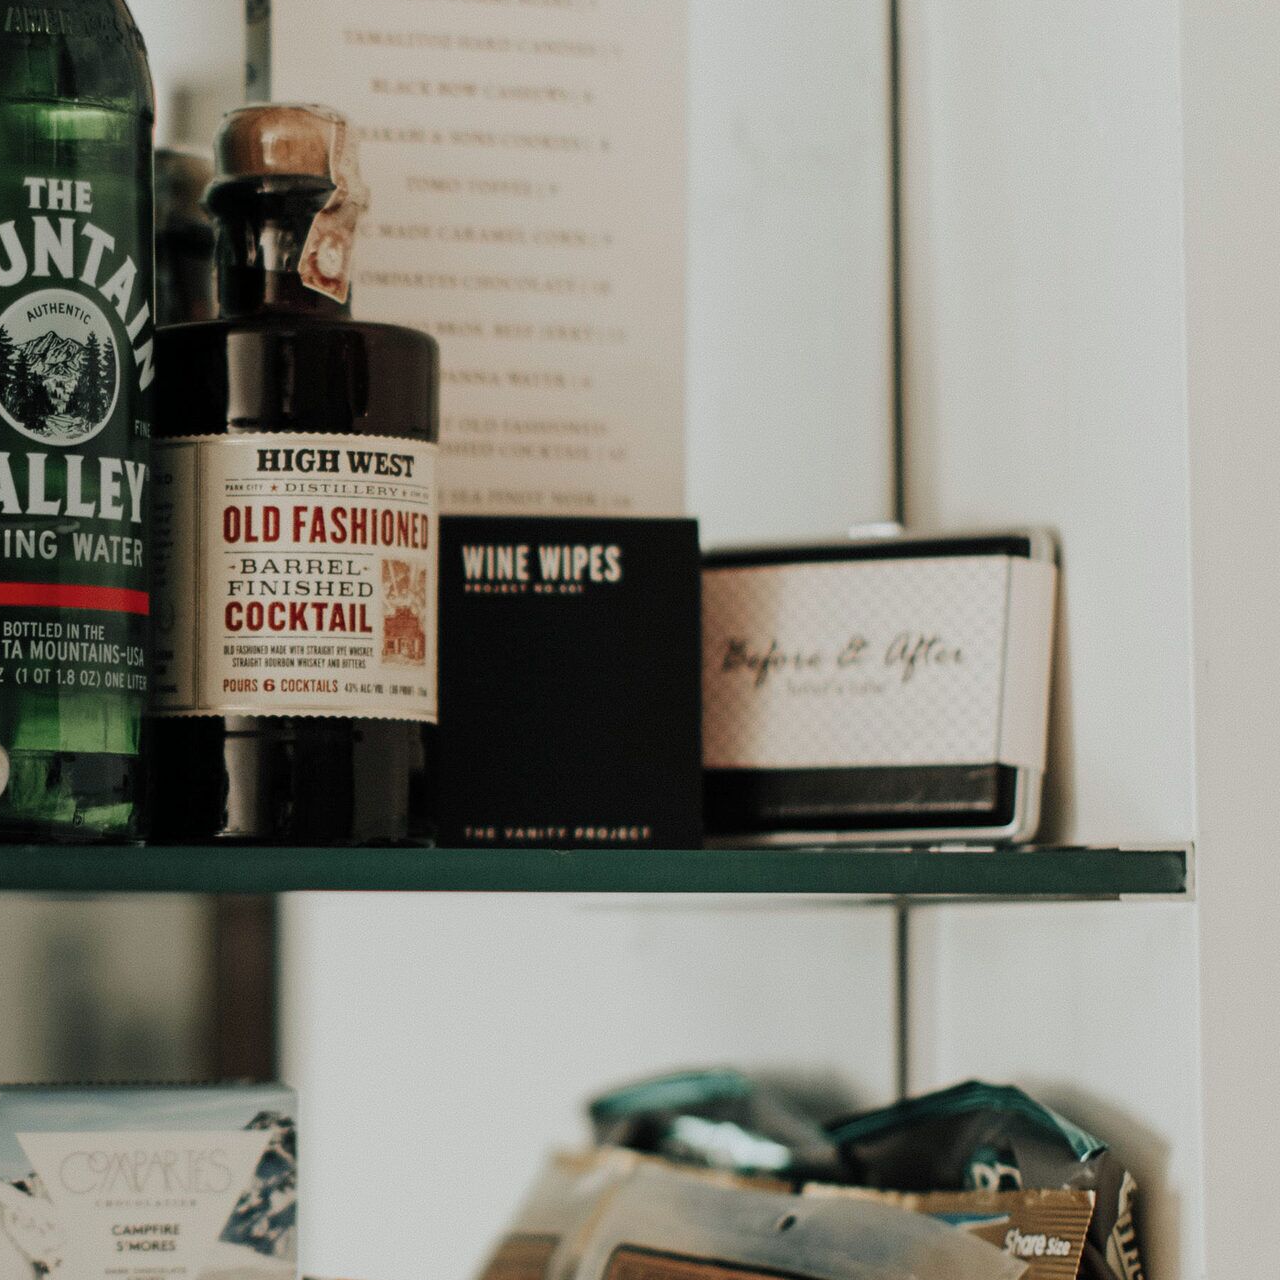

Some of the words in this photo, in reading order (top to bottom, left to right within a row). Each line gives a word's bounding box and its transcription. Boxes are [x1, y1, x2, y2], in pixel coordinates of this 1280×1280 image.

[23, 176, 93, 213] THE
[26, 302, 92, 325] AUTHENTIC
[257, 449, 340, 473] HIGH
[347, 451, 415, 477] WEST
[285, 482, 398, 498] DISTILLERY
[223, 505, 280, 545] OLD
[292, 505, 428, 550] FASHIONED
[72, 533, 143, 568] WATER
[240, 558, 362, 576] BARREL
[462, 544, 529, 581] WINE
[538, 544, 622, 582] WIPES
[227, 580, 374, 598] FINISHED
[465, 583, 527, 593] PROJECT
[224, 600, 373, 633] COCKTAIL
[3, 621, 63, 639] BOTTLED
[67, 623, 80, 639] IN
[83, 624, 105, 641] THE
[236, 645, 269, 656] FASHIONED
[721, 635, 821, 689] Before
[884, 630, 964, 684] After
[15, 667, 28, 685] (1
[34, 668, 52, 685] QT
[57, 669, 75, 686] 1.8
[80, 670, 101, 688] OZ)
[105, 671, 125, 689] ONE
[223, 679, 258, 693] POURS
[263, 679, 276, 693] 6
[280, 679, 338, 694] COCKTAILS
[465, 826, 495, 839] THE
[505, 826, 566, 839] VANITY
[575, 825, 650, 840] PROJECT
[111, 1223, 181, 1237] CAMPFIRE
[116, 1240, 177, 1253] S'MORES
[1047, 1234, 1071, 1256] size
